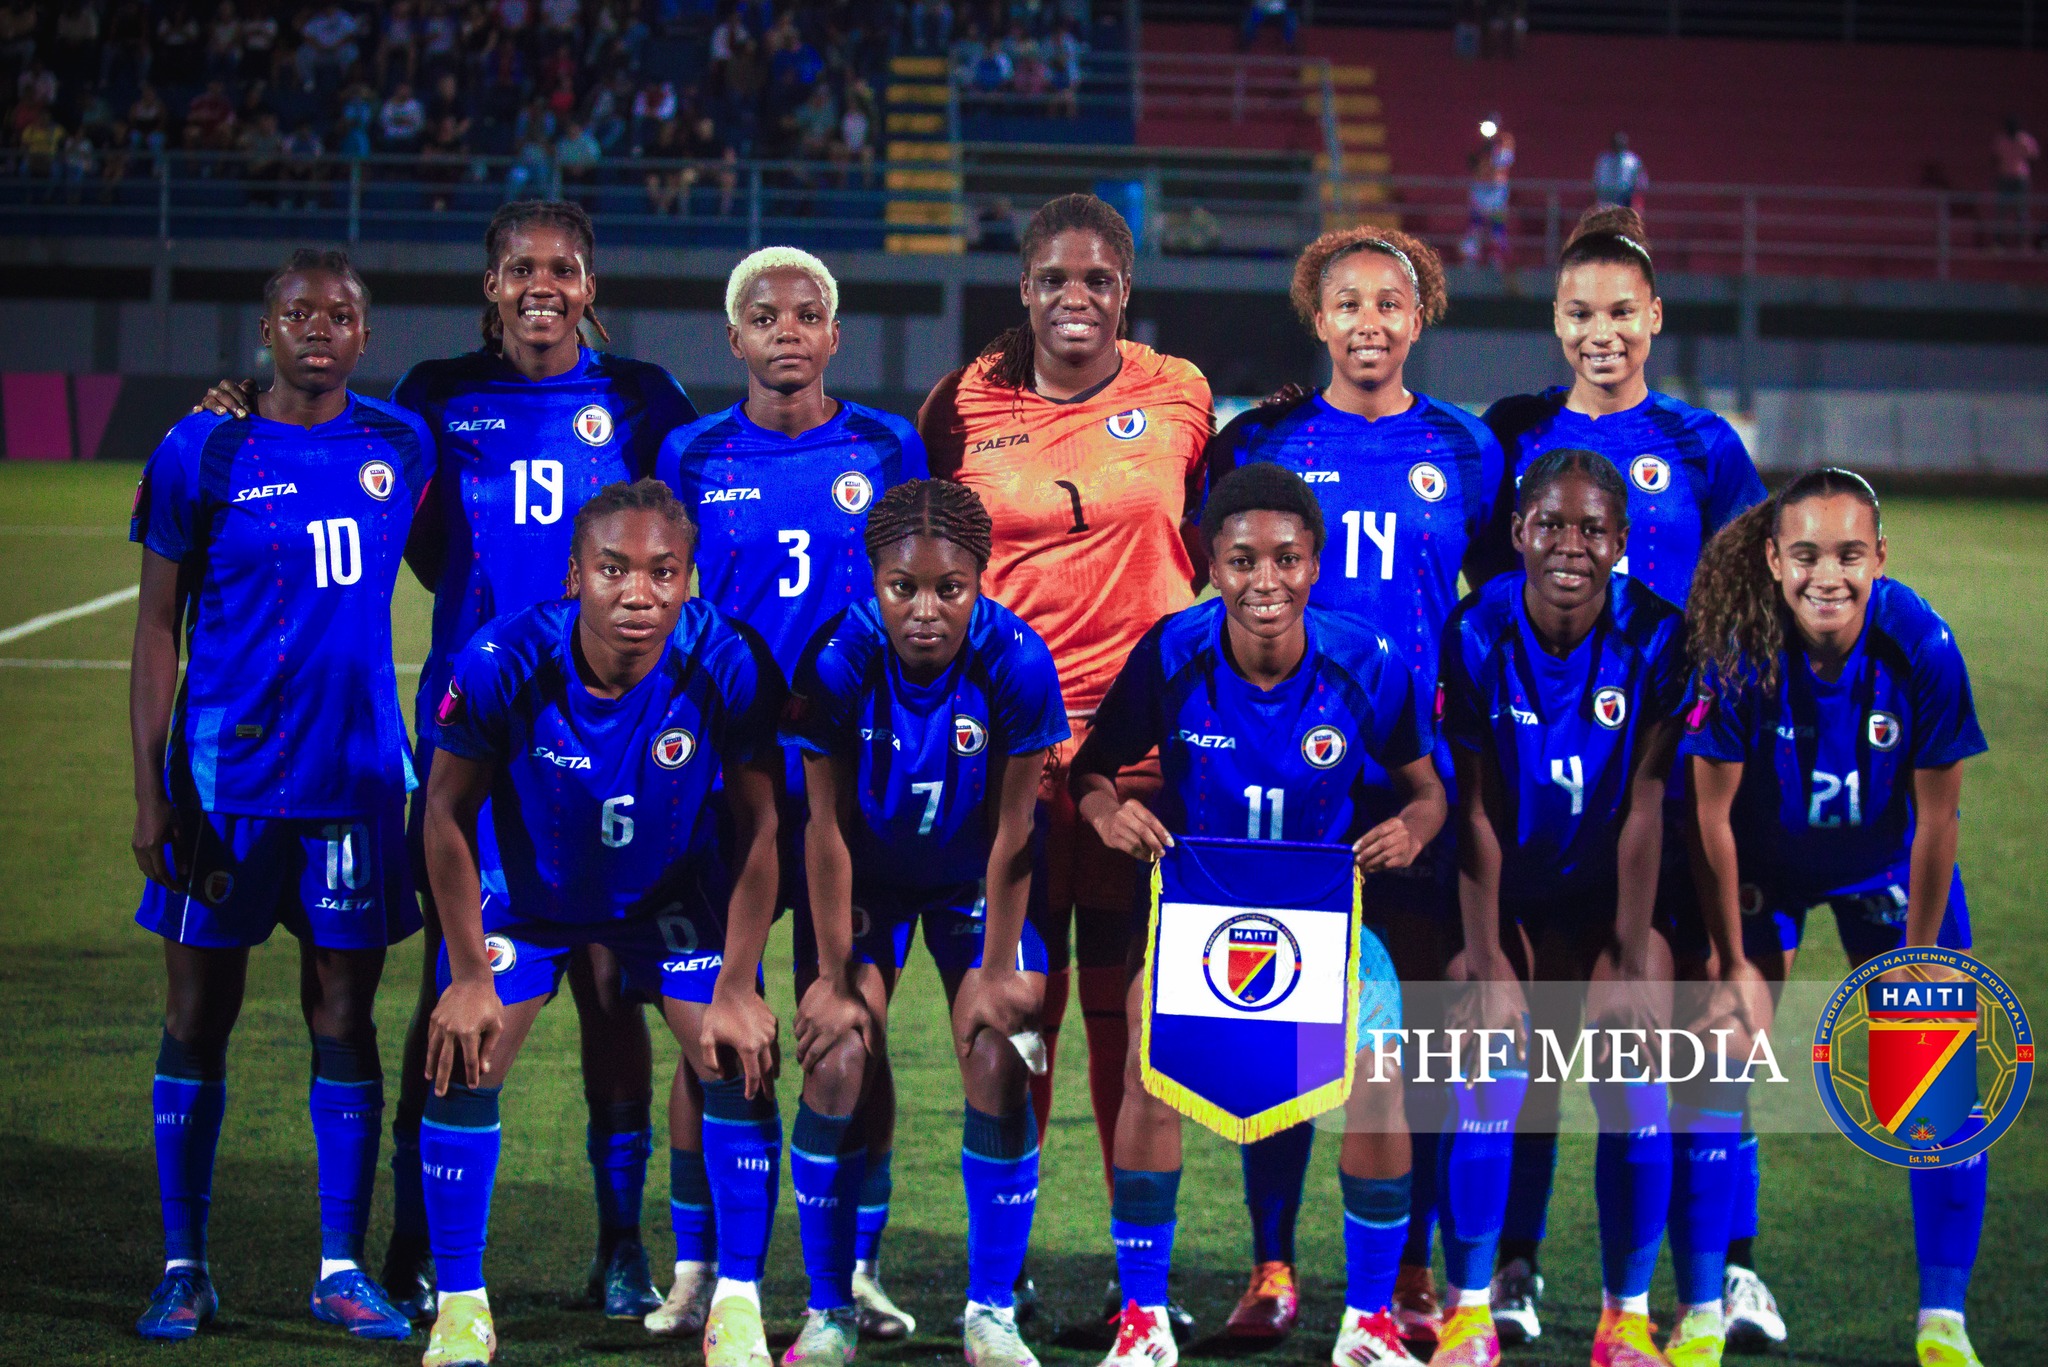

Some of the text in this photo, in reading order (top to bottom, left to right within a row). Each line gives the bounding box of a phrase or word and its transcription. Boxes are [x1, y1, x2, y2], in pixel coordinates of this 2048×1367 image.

[446, 417, 506, 432] SAETA
[970, 433, 1030, 454] SAETA
[232, 482, 298, 503] SAETA
[510, 459, 564, 525] 19
[700, 488, 761, 505] SAETA
[1296, 471, 1340, 483] ETA
[1054, 479, 1090, 535] 1
[306, 516, 362, 588] 10
[778, 529, 811, 598] 3
[1342, 510, 1397, 580] 14
[531, 746, 592, 770] SAETA
[1171, 729, 1237, 750] SAETA
[911, 780, 944, 835] 7
[1244, 784, 1284, 840] 11
[1551, 755, 1584, 815] 4
[1808, 769, 1861, 828] 21
[601, 794, 635, 848] 6
[321, 823, 371, 890] 10
[655, 901, 699, 954] 6
[1234, 930, 1273, 941] HAITI
